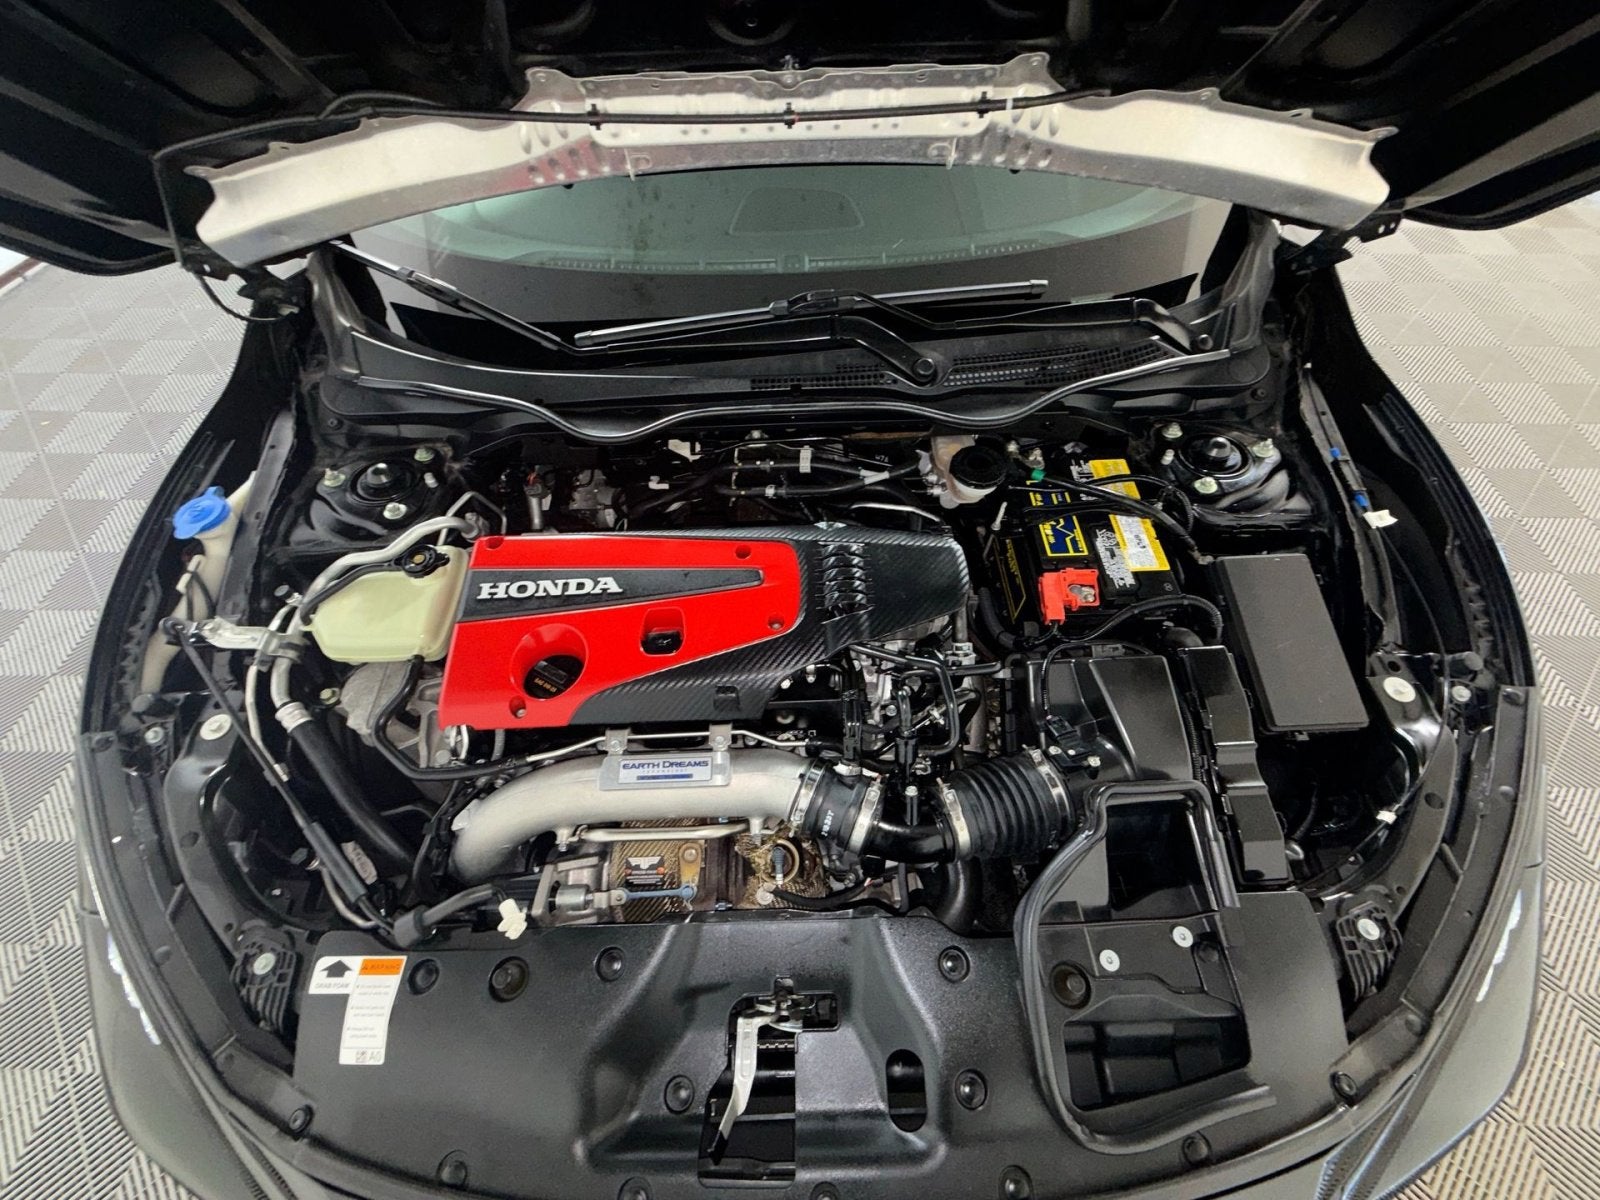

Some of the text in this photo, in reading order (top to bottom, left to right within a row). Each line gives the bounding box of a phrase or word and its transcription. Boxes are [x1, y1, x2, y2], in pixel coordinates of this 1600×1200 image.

[476, 576, 624, 600] HONDA
[622, 760, 709, 770] EARTH DREAMS
